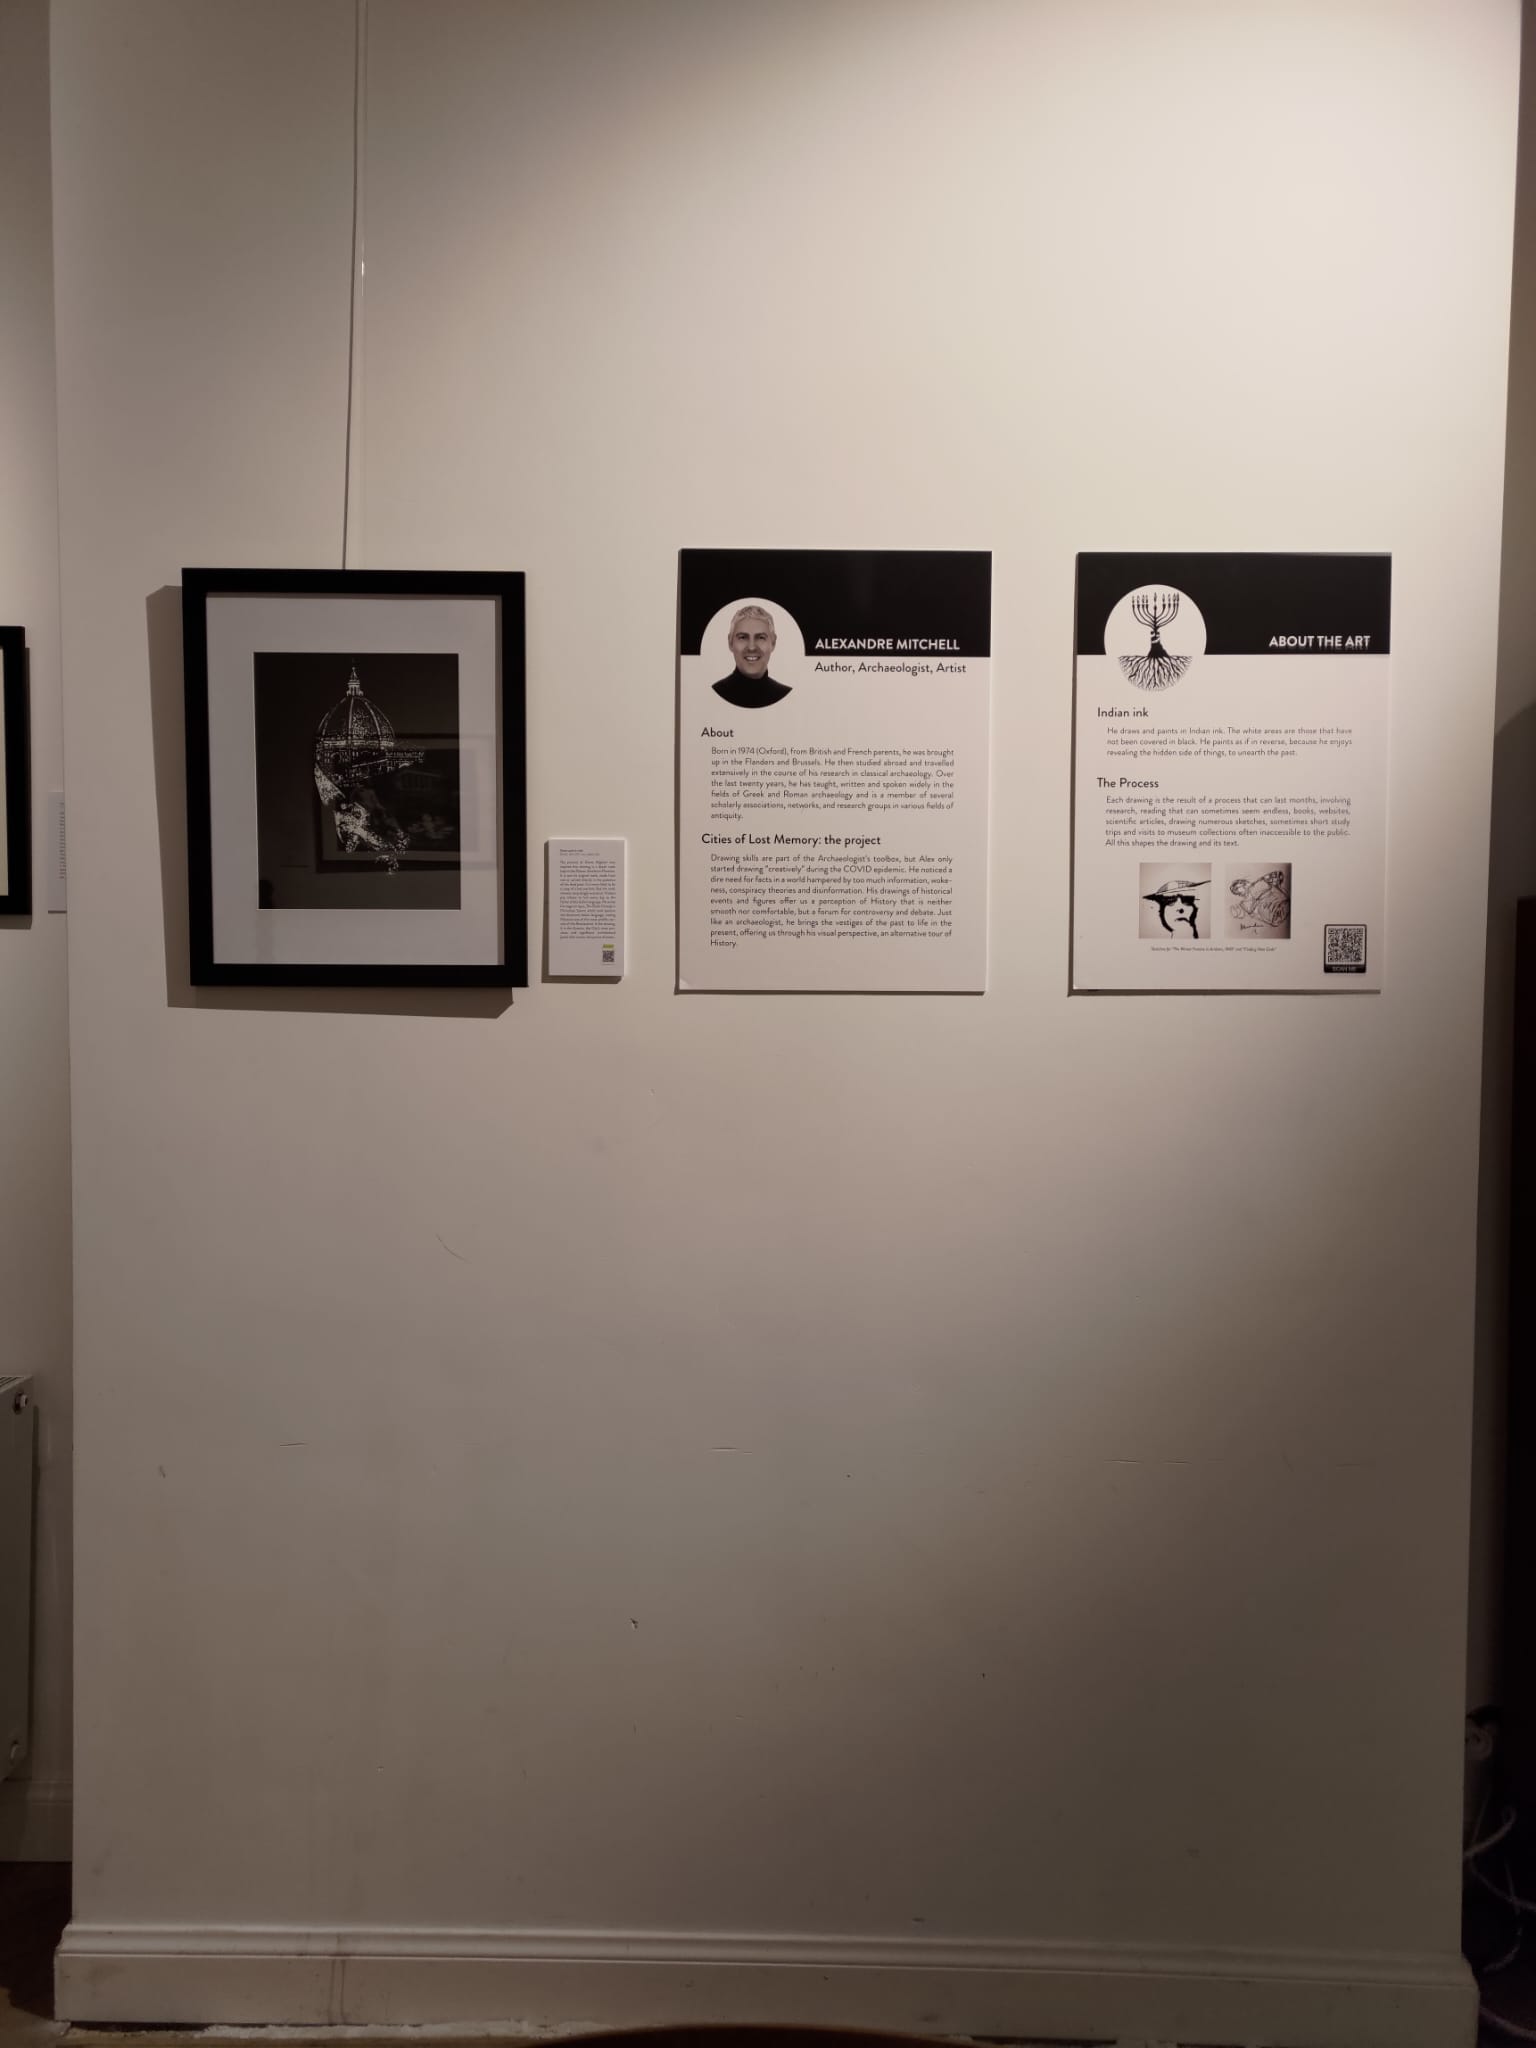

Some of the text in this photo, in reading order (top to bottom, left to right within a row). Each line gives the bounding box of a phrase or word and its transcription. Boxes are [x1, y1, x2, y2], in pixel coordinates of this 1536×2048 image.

[815, 638, 959, 650] ALEXANDRE MITCHELL
[1269, 635, 1370, 647] ABOUT THE ART
[814, 661, 966, 676] Author, Archaeologist, Artist
[1097, 707, 1148, 718] Indian ink
[701, 726, 733, 738] About
[1157, 726, 1178, 736] paints
[1212, 737, 1233, 747] paints
[1329, 739, 1352, 747] enjoys
[872, 748, 901, 758] parents,
[926, 748, 953, 758] brought
[1106, 748, 1138, 758] revealing
[1203, 748, 1226, 758] things,
[711, 760, 720, 768] up
[710, 768, 750, 779] extensively
[1096, 777, 1158, 789] The Process
[1105, 806, 1137, 815] research,
[1140, 806, 1166, 816] reading
[1262, 806, 1290, 816] endless,
[1105, 828, 1121, 838] trips
[1326, 828, 1350, 838] public.
[701, 833, 880, 848] Cities of Lost Memory: the project
[1131, 838, 1154, 848] shapes
[1169, 838, 1197, 849] drawing
[736, 864, 764, 875] drawing
[806, 865, 828, 875] during
[728, 886, 766, 896] conspiracy
[879, 886, 909, 897] drawings
